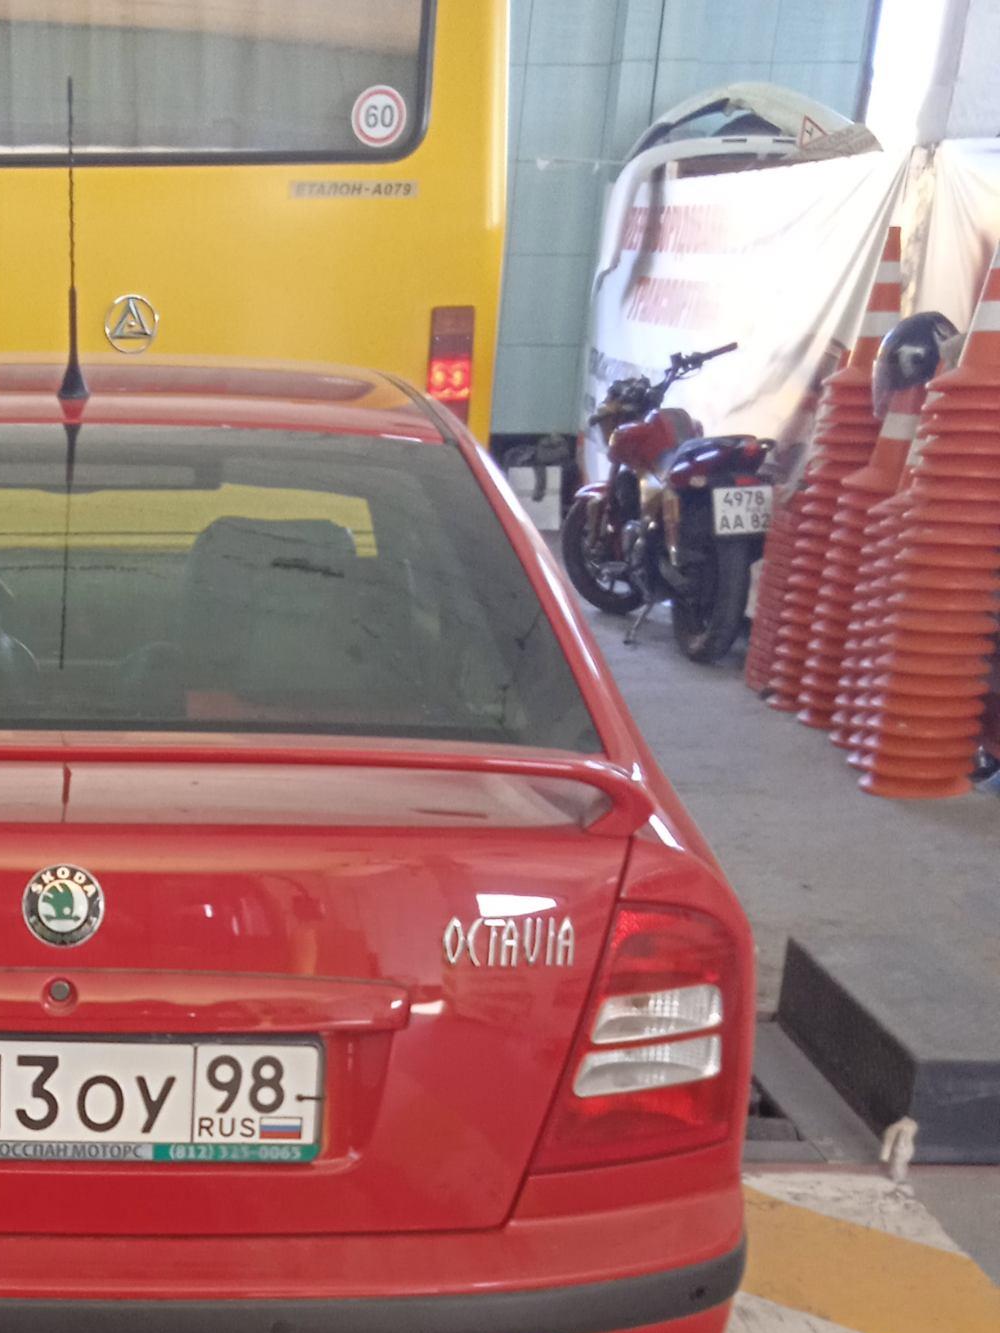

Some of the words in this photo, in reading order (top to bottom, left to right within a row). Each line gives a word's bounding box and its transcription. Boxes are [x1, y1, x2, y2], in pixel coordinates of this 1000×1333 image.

[365, 104, 395, 128] 60
[723, 490, 765, 507] 4978
[443, 916, 575, 967] OCTAVIA
[206, 1055, 285, 1114] 98
[198, 1117, 256, 1138] RUS
[73, 1144, 142, 1159] МОТОРС
[168, 1144, 214, 1161] (812)
